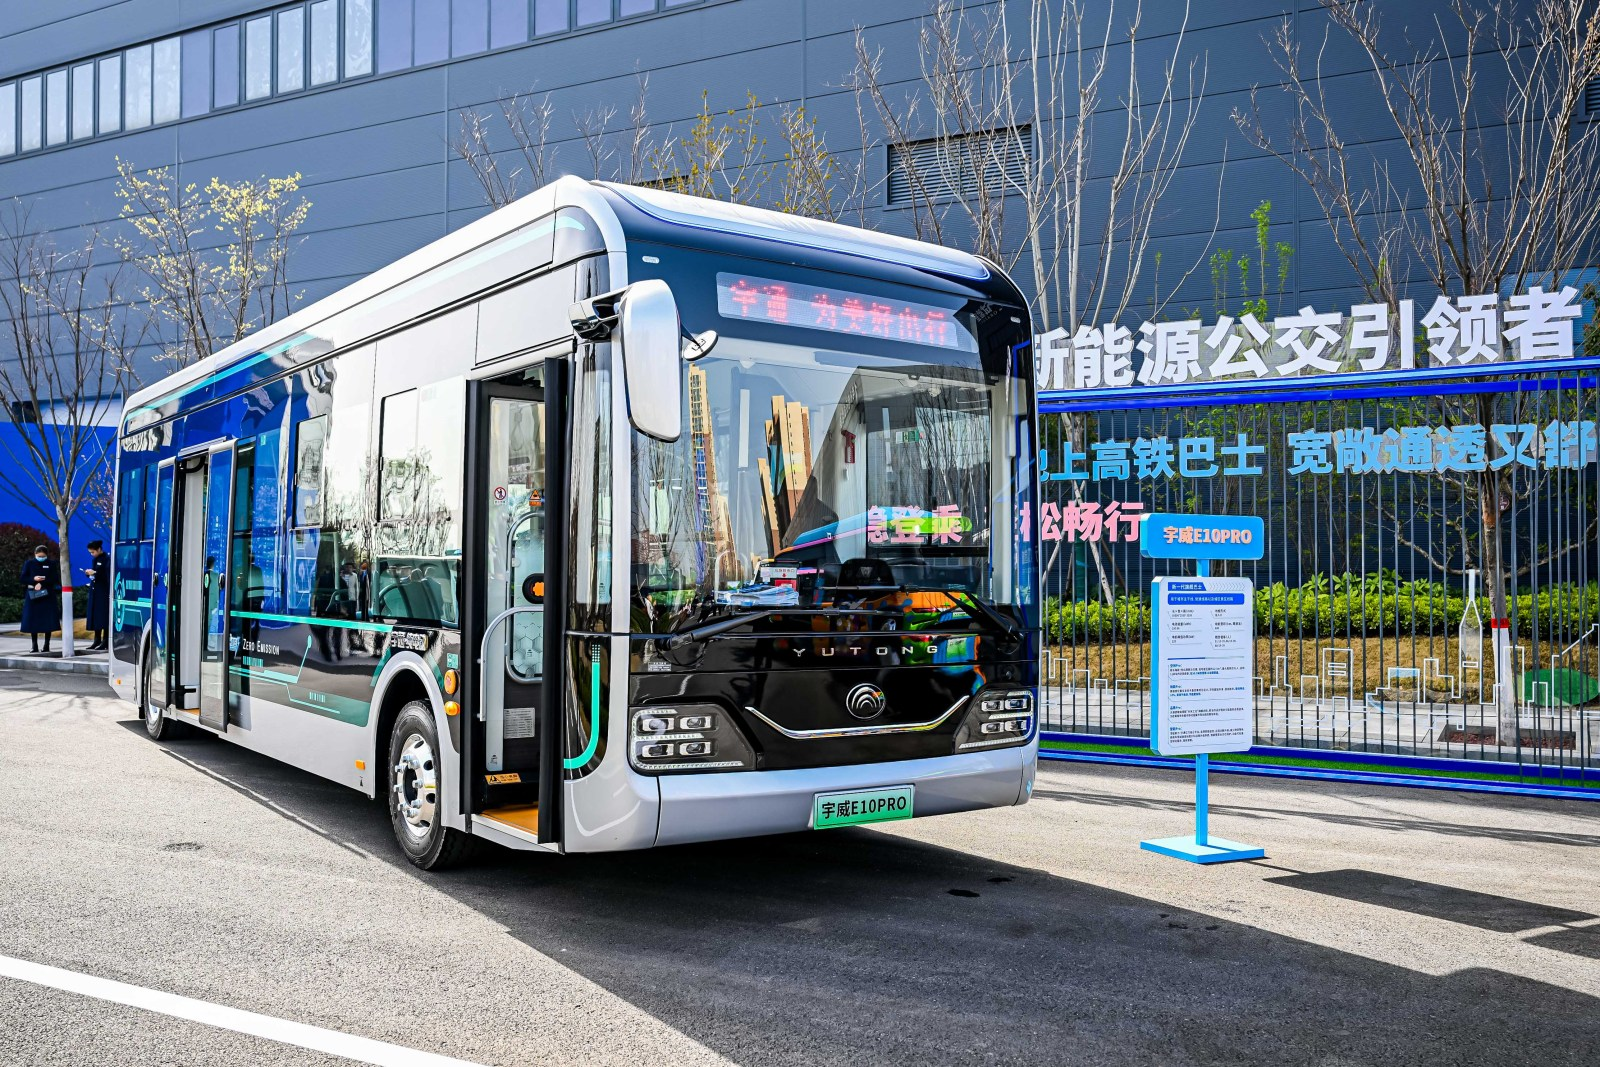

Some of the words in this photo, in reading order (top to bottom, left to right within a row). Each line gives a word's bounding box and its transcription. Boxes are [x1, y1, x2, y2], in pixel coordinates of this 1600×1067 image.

[1035, 286, 1583, 389] 新能源公交引领者
[1040, 432, 1266, 482] 上高铁巴士
[1015, 501, 1144, 543] 松畅行
[1163, 526, 1252, 544] 宇威E10PRO
[793, 646, 939, 657] YUTONG
[821, 796, 907, 819] 宇威E10PRO
